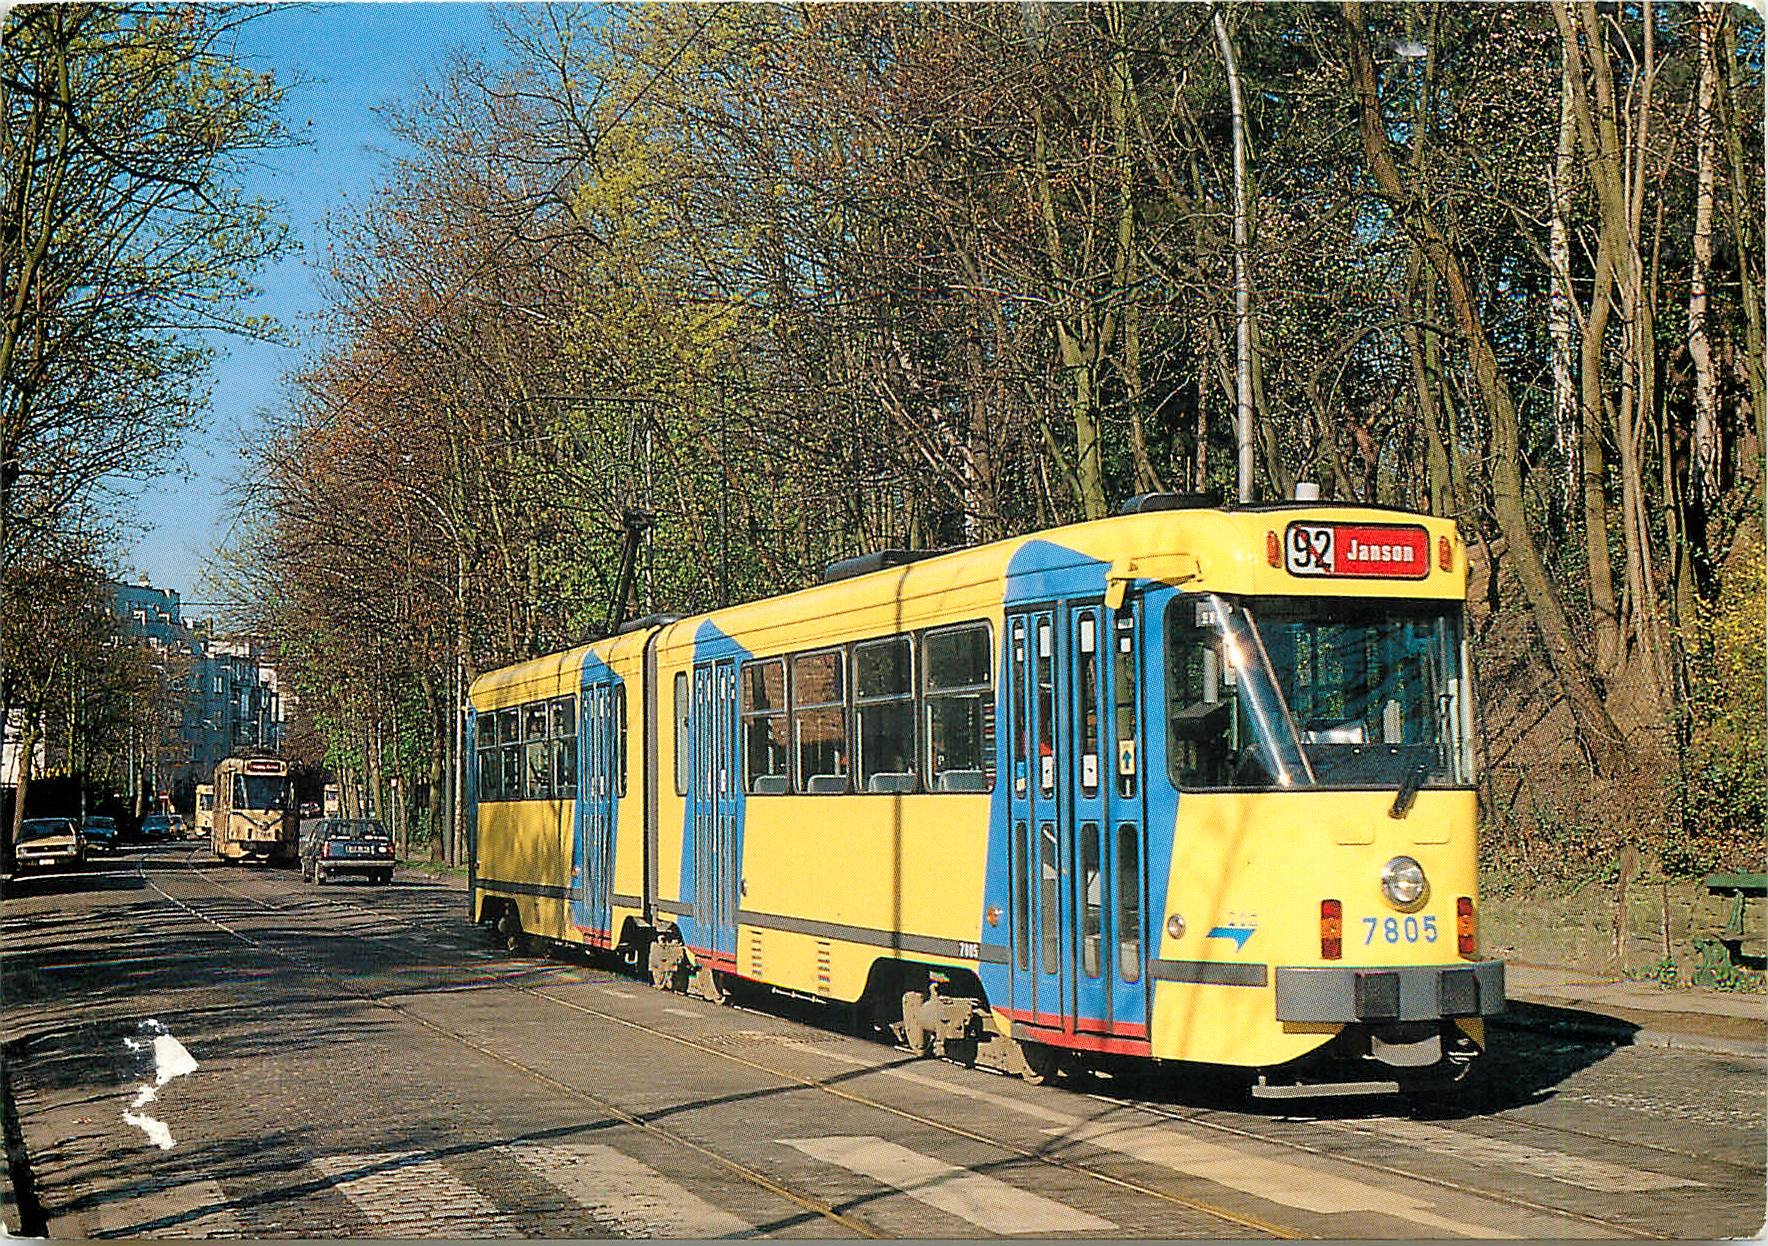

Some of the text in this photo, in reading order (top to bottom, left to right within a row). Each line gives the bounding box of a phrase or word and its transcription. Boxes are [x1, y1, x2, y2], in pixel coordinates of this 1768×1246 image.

[1294, 528, 1415, 568] 92 Janson
[1362, 915, 1438, 945] 7805
